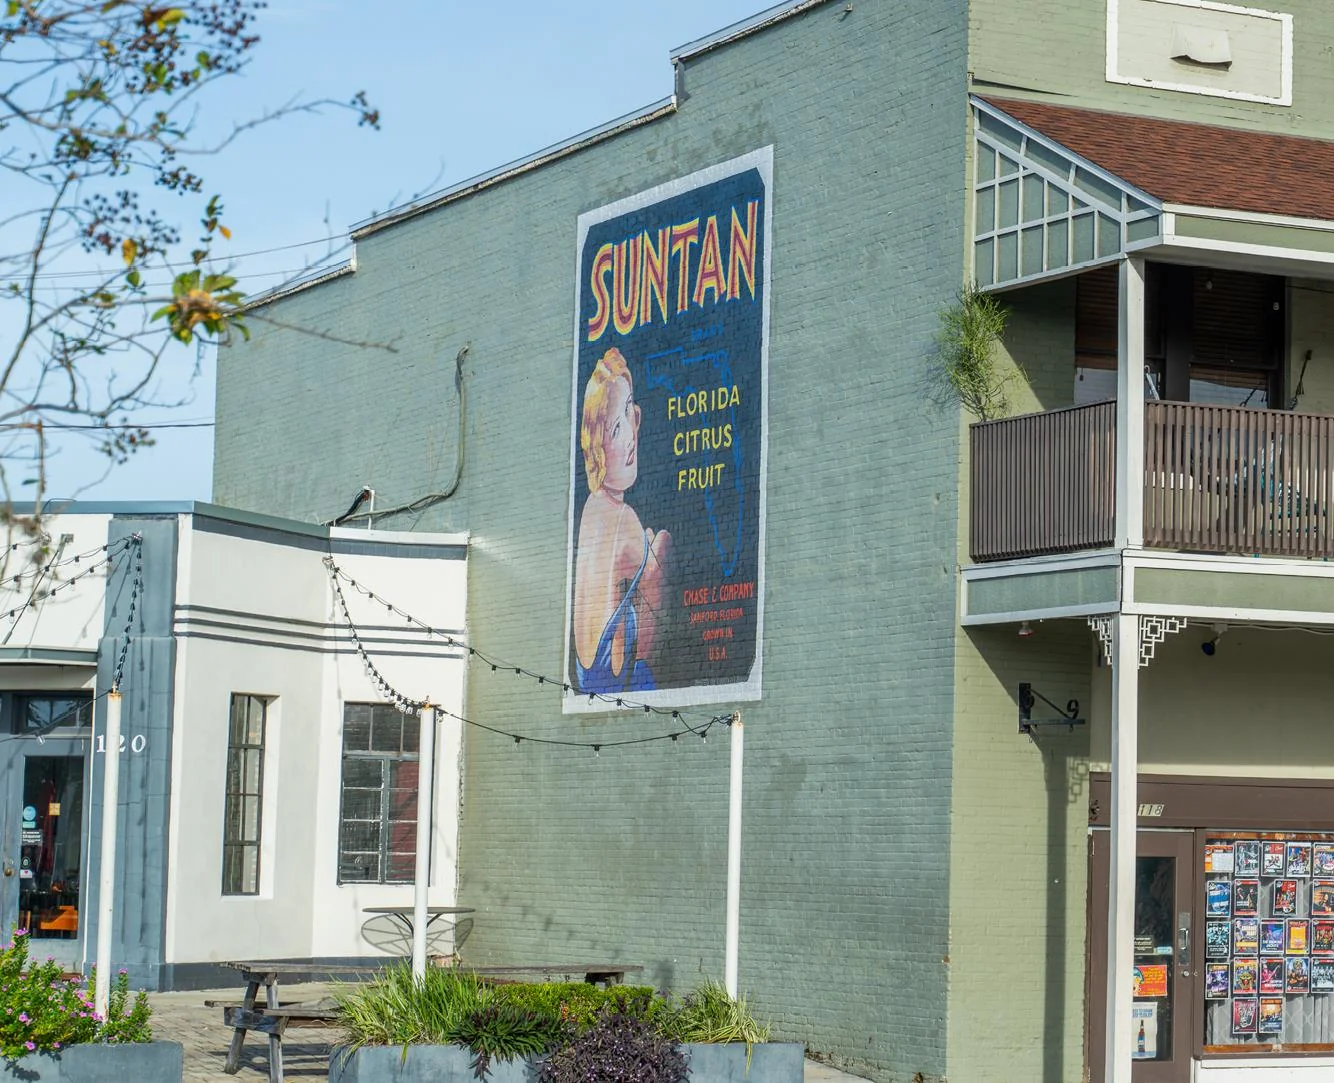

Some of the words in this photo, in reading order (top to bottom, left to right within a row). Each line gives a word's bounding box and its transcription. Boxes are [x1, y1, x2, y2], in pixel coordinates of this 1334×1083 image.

[587, 199, 758, 342] SUNTAN
[667, 385, 740, 421] FLORIDA
[673, 423, 733, 456] CITRUS
[678, 463, 725, 491] FRUIT
[683, 588, 708, 607] CHASE
[719, 582, 754, 602] COMPANY
[703, 629, 724, 641] GROWN
[725, 626, 734, 639] IN
[1140, 804, 1163, 816] 118
